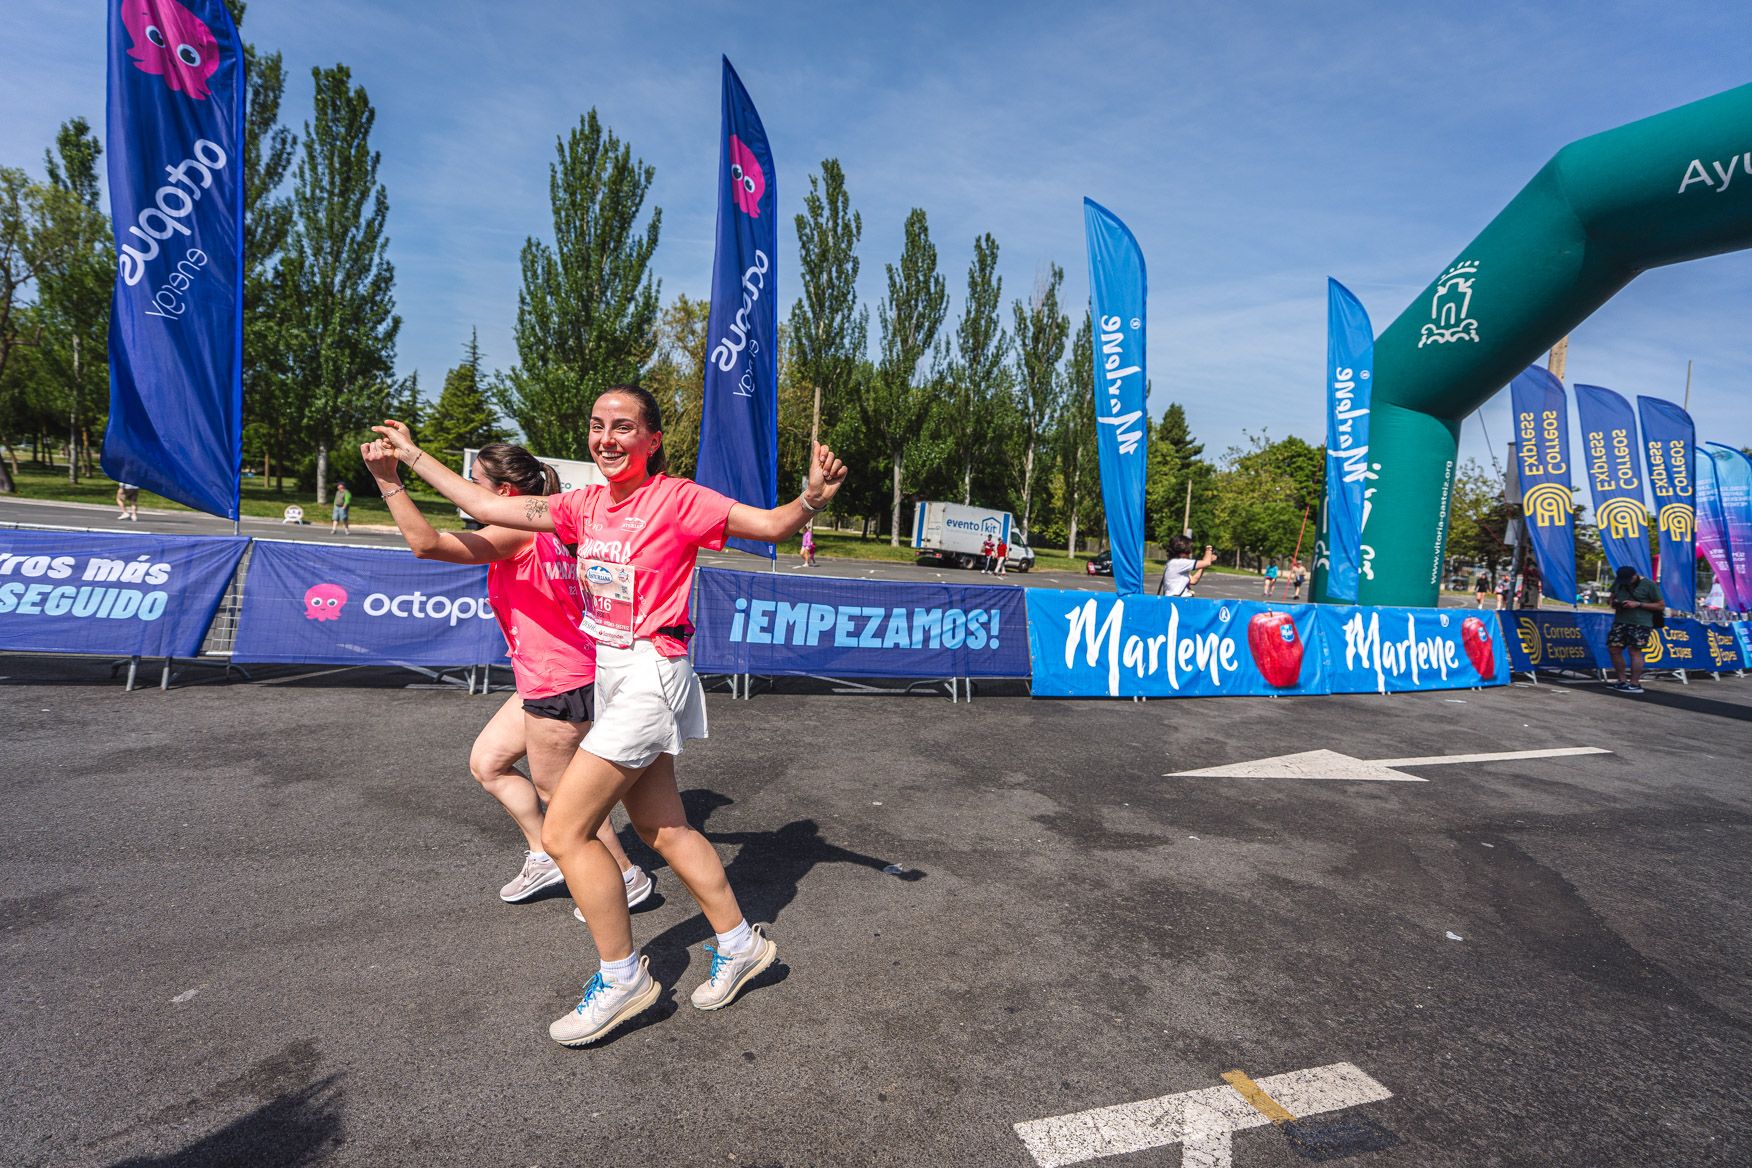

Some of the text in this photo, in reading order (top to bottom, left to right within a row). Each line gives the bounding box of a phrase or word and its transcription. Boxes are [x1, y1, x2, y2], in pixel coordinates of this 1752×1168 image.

[946, 518, 998, 534] evento kit
[1430, 460, 1454, 585] www.vitoria-gasteiz.org
[81, 555, 171, 585] más
[0, 581, 169, 621] SEGUIDO
[363, 591, 496, 627] octopu
[729, 599, 999, 650] ¡EMPEZAMOS!
[1543, 623, 1582, 639] Correos
[1065, 597, 1238, 696] Marlene
[1342, 611, 1459, 693] Marlene
[1547, 643, 1586, 660] Express
